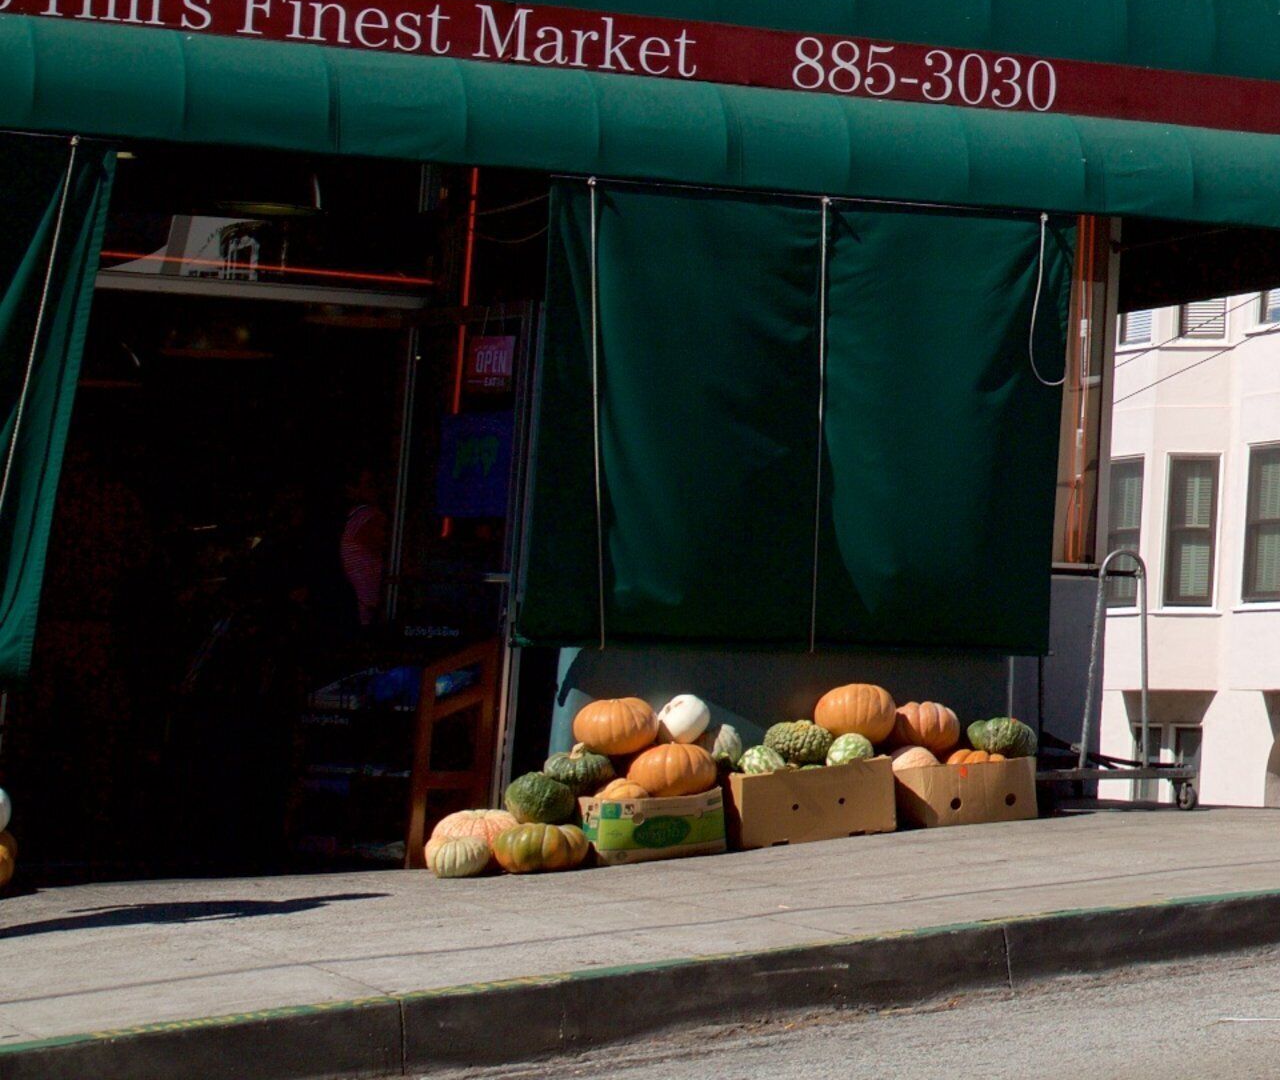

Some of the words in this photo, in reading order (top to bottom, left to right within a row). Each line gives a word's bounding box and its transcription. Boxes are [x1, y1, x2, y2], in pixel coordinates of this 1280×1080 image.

[472, 3, 698, 78] Market
[792, 36, 1057, 112] 885-3030
[475, 350, 506, 374] OPEN
